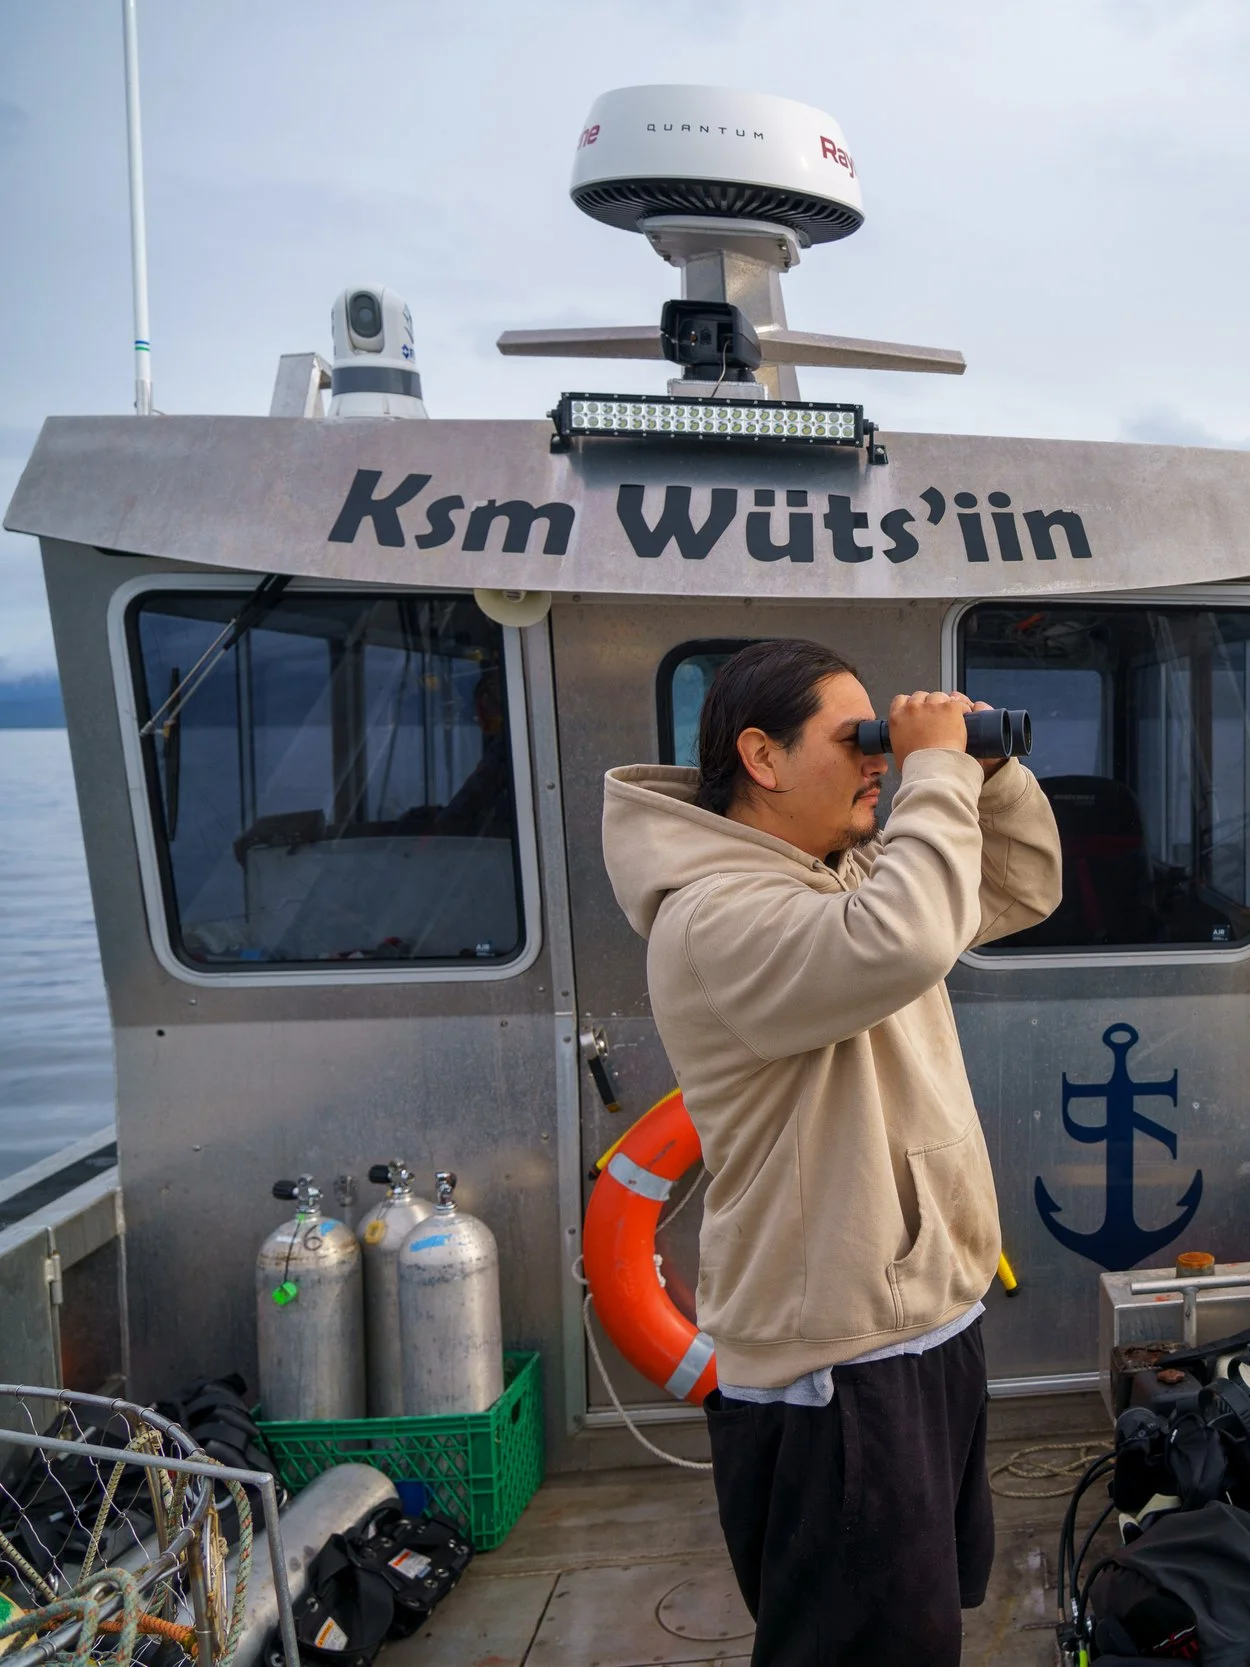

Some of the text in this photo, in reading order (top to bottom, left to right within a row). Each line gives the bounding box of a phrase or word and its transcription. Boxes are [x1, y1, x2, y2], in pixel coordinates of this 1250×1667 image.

[577, 124, 600, 151] ne
[646, 123, 764, 140] QUANTUM
[820, 135, 857, 179] Ray
[328, 469, 576, 556] Ksm
[303, 1224, 324, 1251] 6
